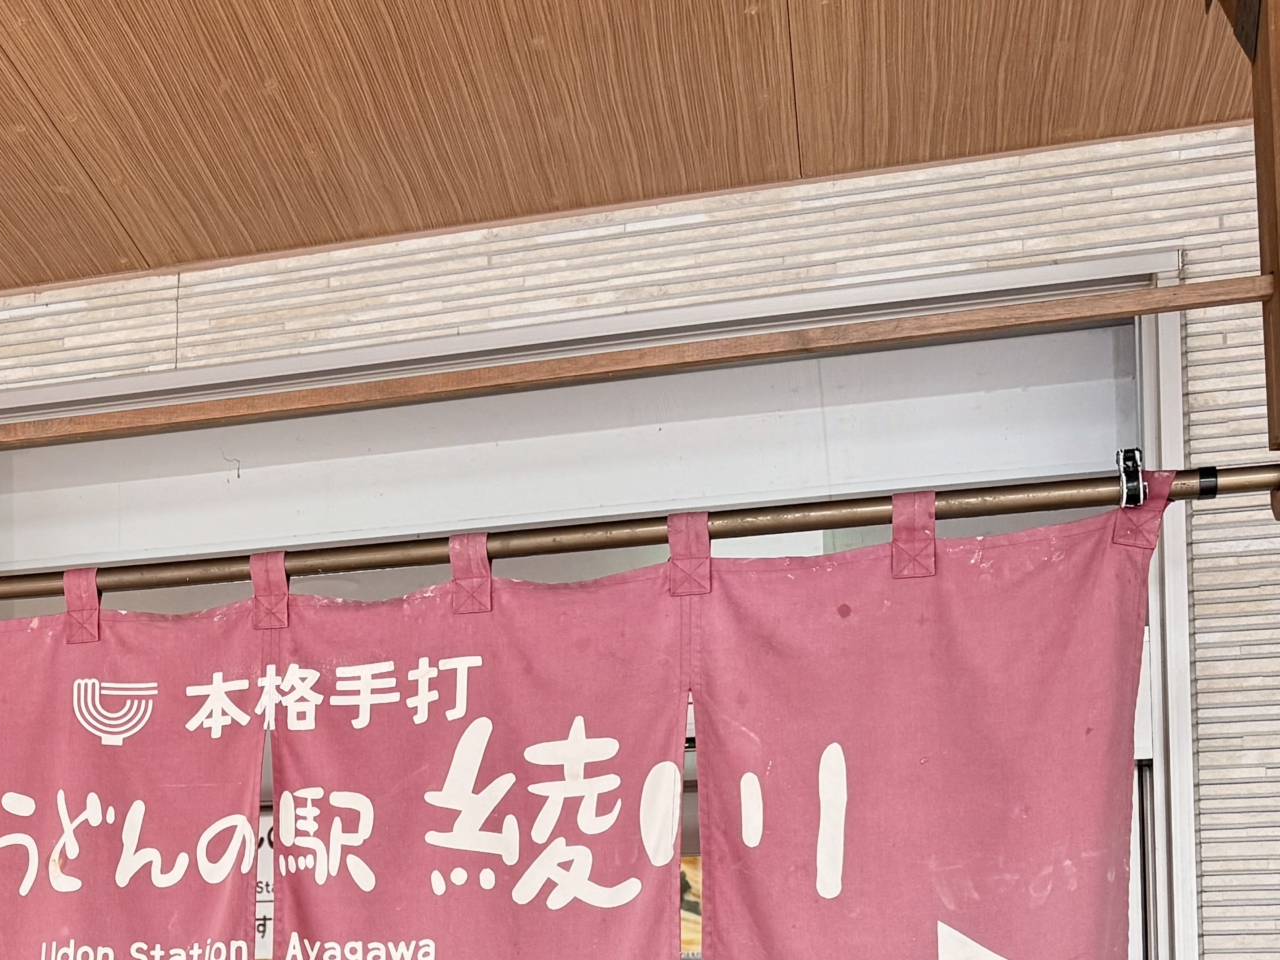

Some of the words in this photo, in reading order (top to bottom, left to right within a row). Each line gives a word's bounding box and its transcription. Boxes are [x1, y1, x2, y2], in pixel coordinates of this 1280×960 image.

[185, 656, 473, 734] 本格手打
[424, 715, 847, 910] 綾川
